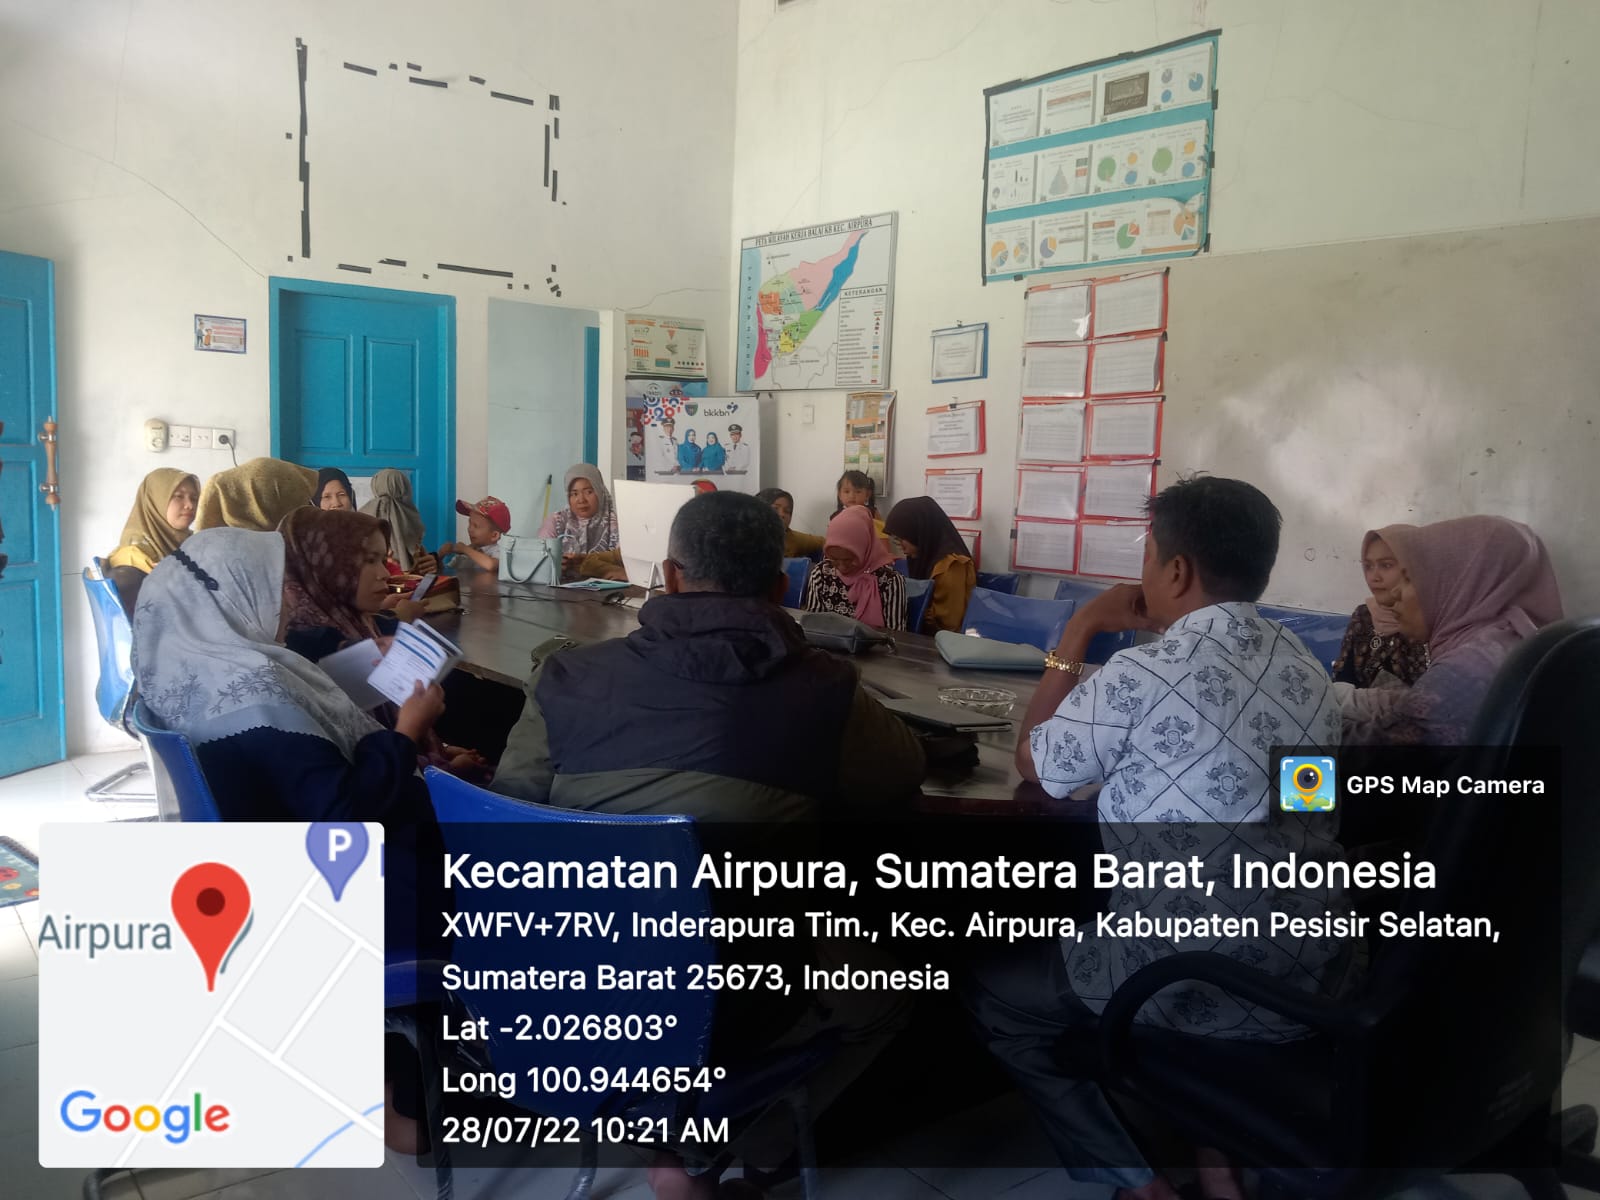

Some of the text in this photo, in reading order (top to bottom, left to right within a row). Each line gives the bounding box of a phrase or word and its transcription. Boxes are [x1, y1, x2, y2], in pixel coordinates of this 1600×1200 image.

[791, 229, 807, 241] KERJA
[848, 218, 872, 230] AIRPURA
[844, 287, 883, 297] KETERANGAN
[703, 409, 730, 417] bkkbn
